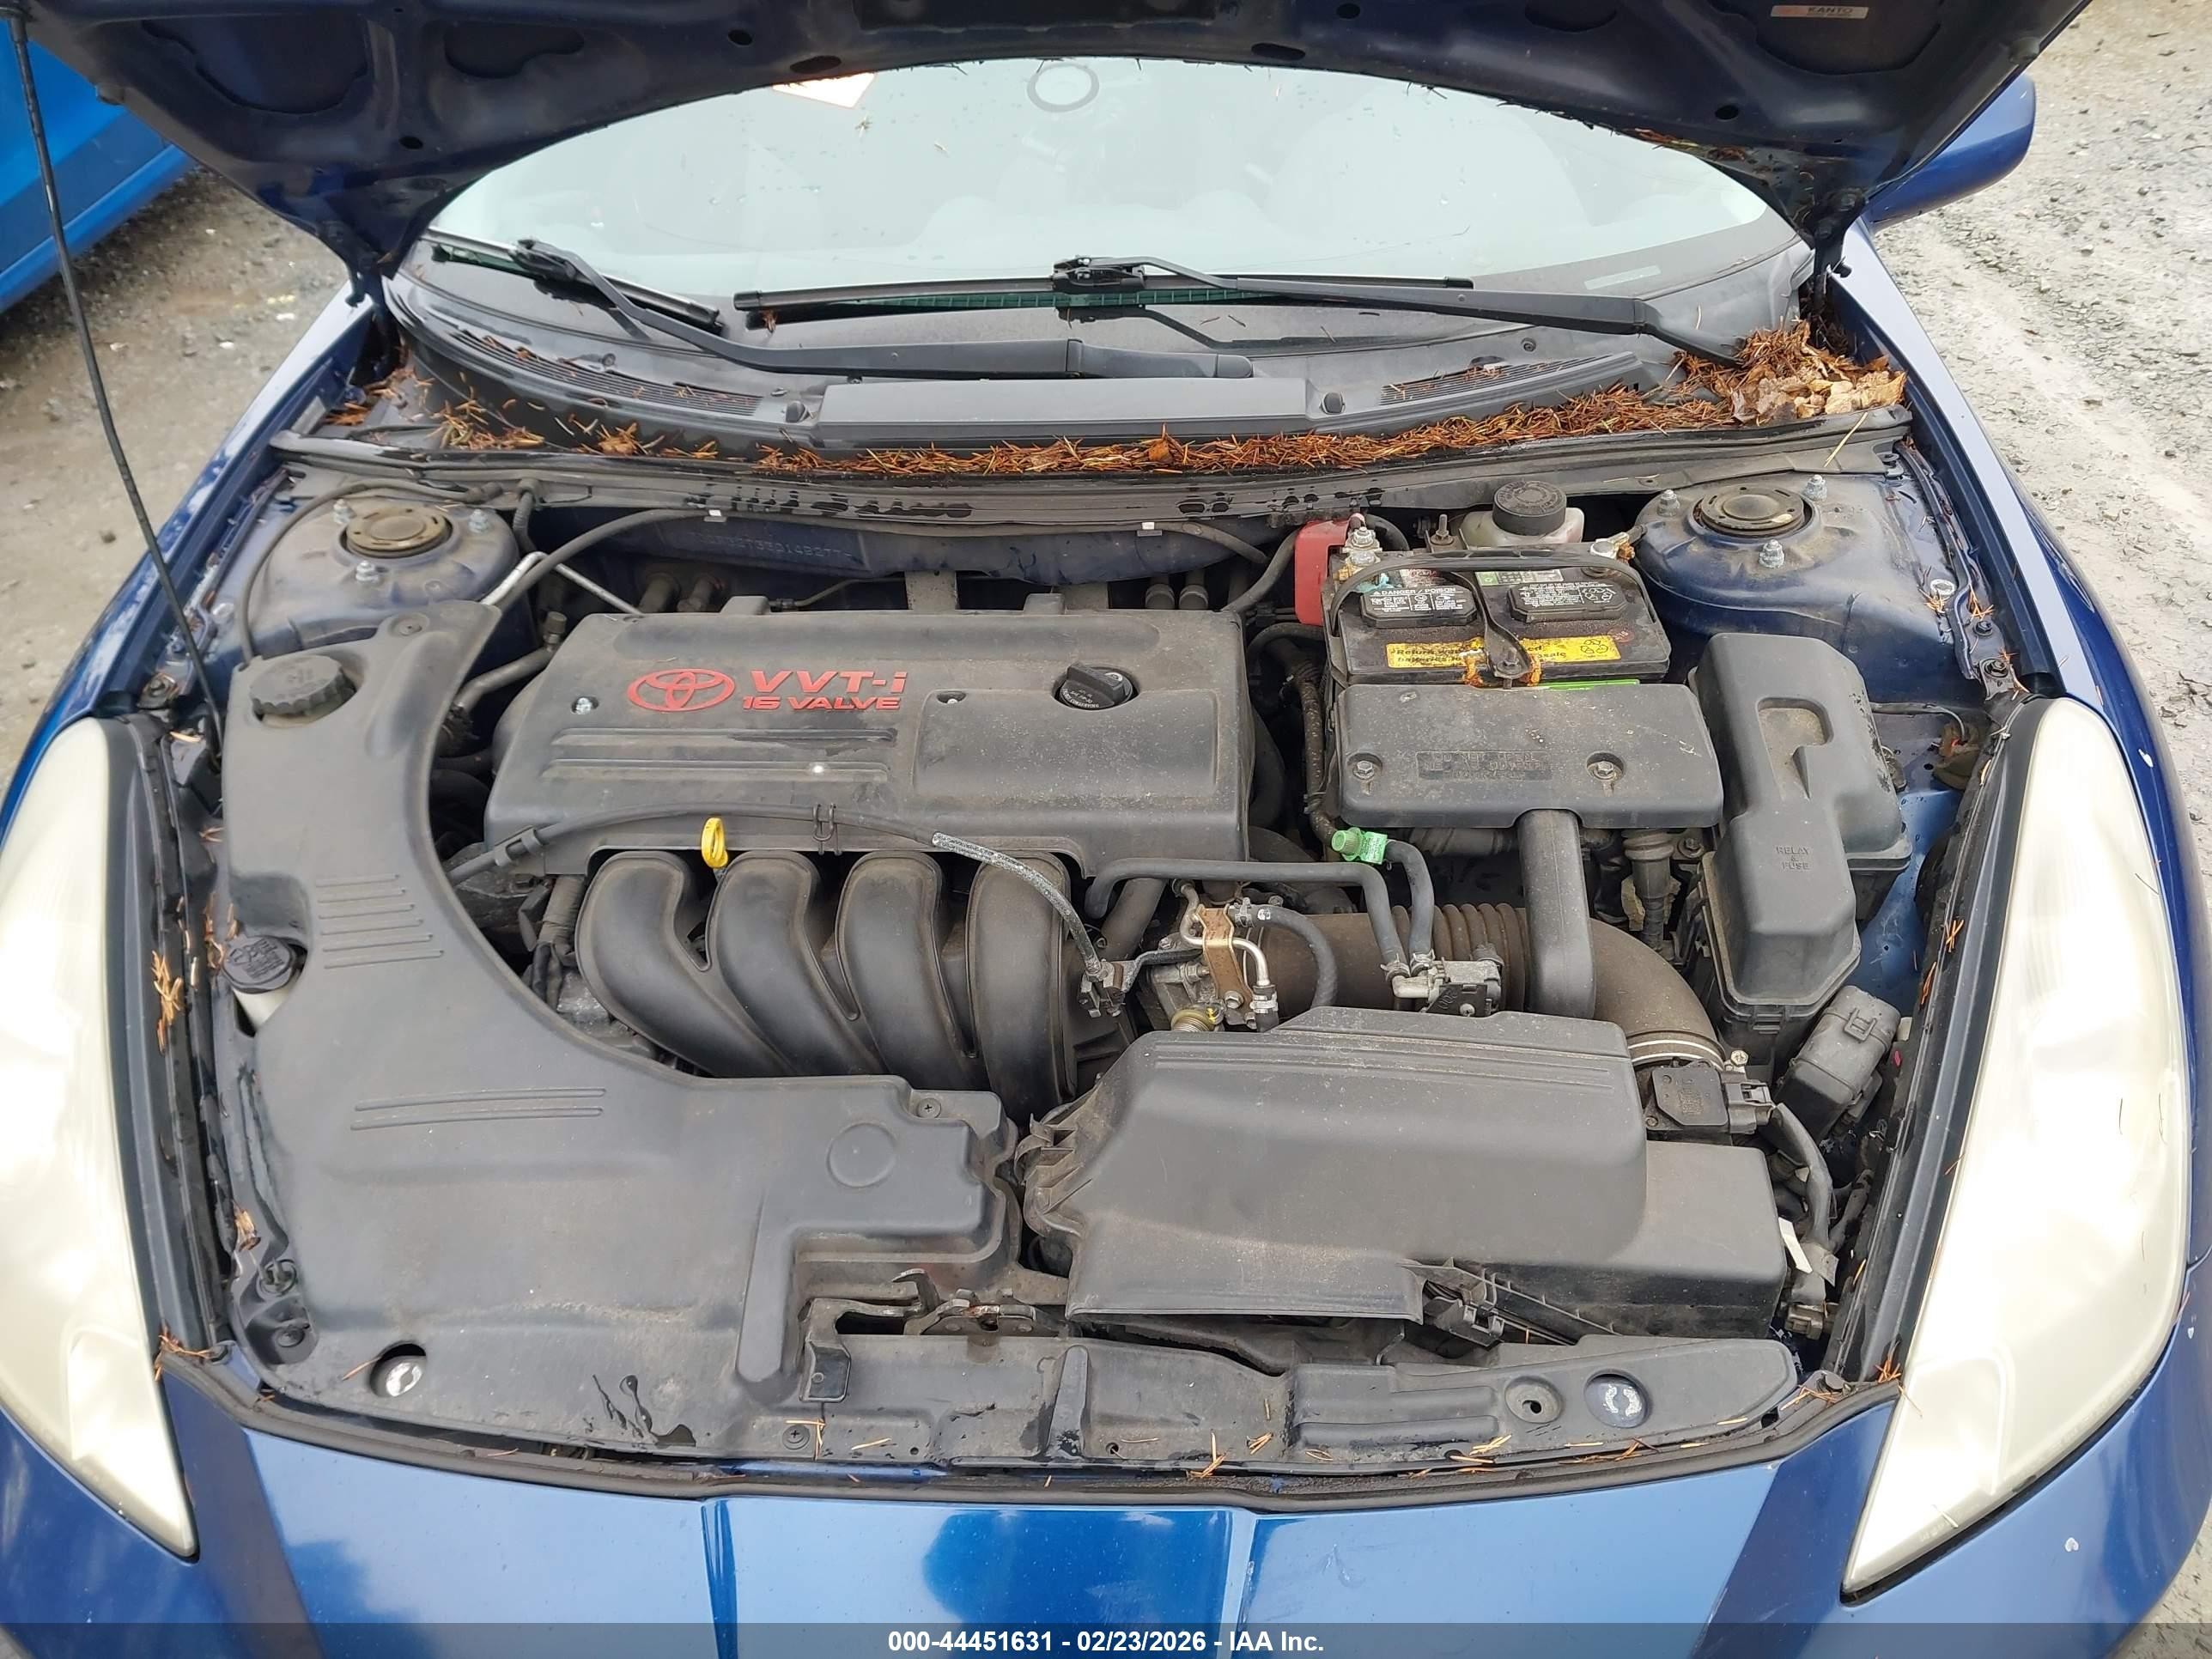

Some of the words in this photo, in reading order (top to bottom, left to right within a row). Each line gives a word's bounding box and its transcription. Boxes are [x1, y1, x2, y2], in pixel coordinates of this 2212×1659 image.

[750, 670, 908, 694] VVT-i
[742, 696, 781, 711] 16
[787, 696, 902, 711] VALVE
[1776, 846, 1809, 855] RELAY
[1782, 861, 1810, 870] FUSE
